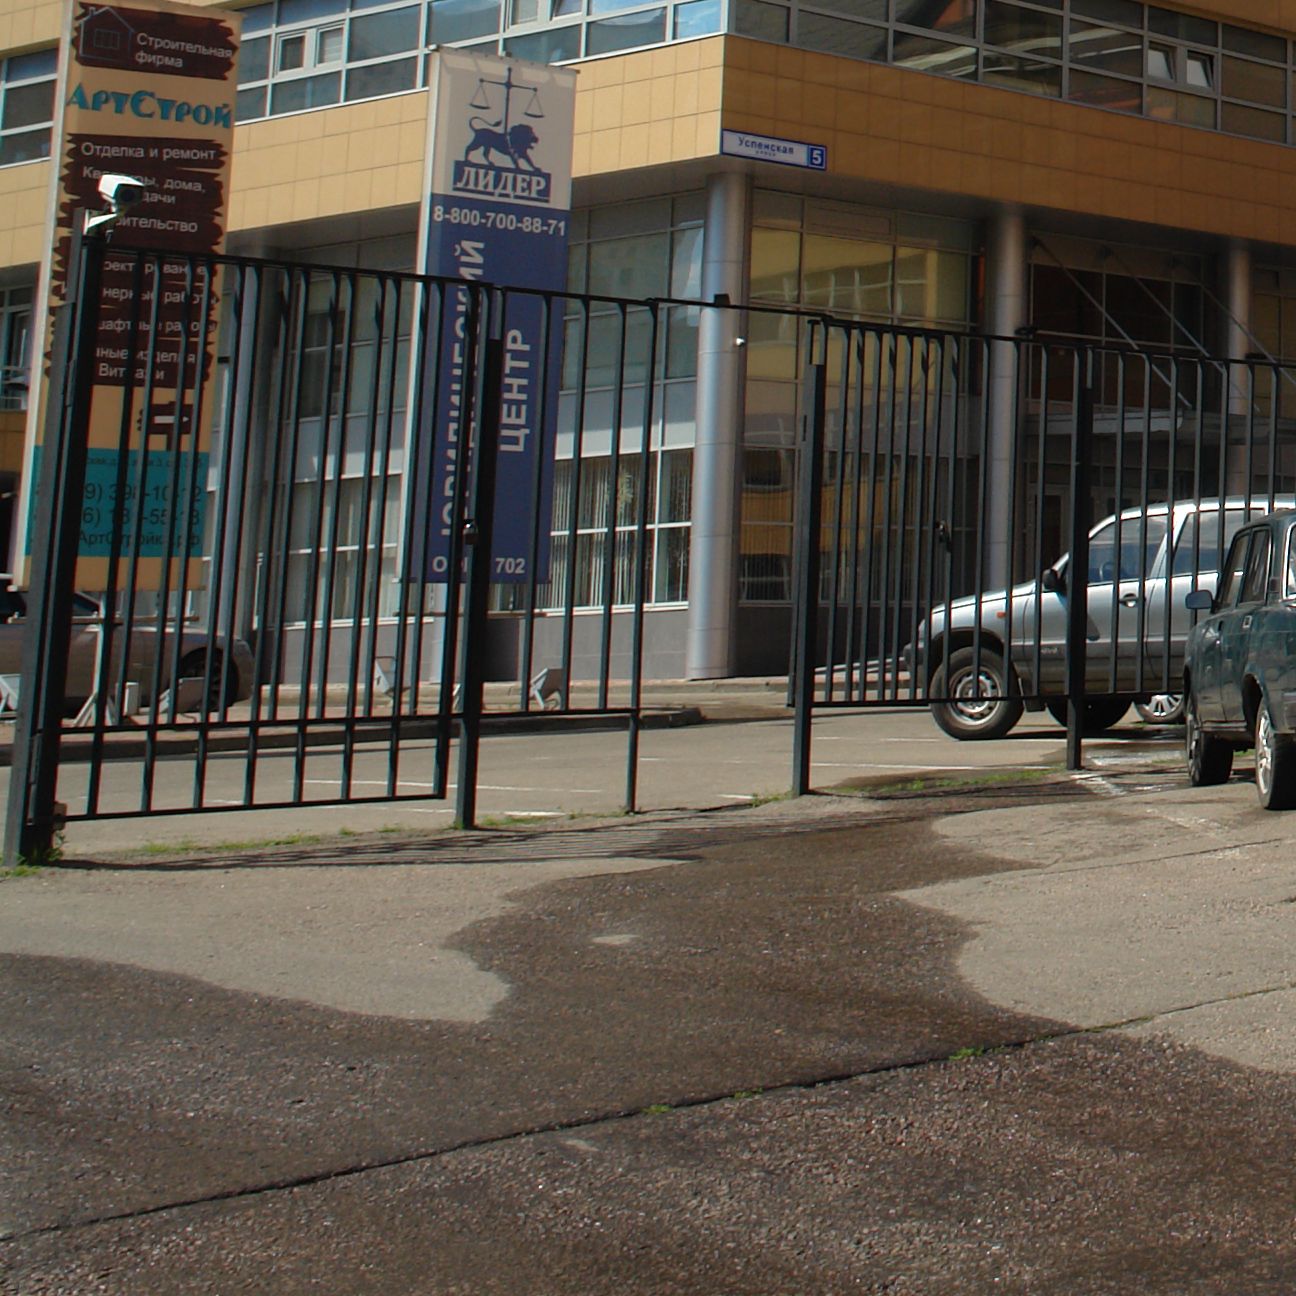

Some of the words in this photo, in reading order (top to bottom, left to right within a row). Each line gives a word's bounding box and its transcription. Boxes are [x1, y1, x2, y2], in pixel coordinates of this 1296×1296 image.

[135, 50, 184, 68] фирма
[136, 33, 234, 59] Строительная
[81, 141, 145, 158] Отделка
[149, 147, 159, 157] и
[163, 147, 216, 161] ремонт
[738, 135, 794, 155] Успенская
[811, 149, 822, 165] 5
[163, 178, 206, 194] дома,
[454, 166, 549, 199] ЛИДЕР
[433, 205, 566, 236] 8-800-700-88-71
[500, 328, 531, 452] ЦЕНТР
[495, 557, 525, 574] 702
